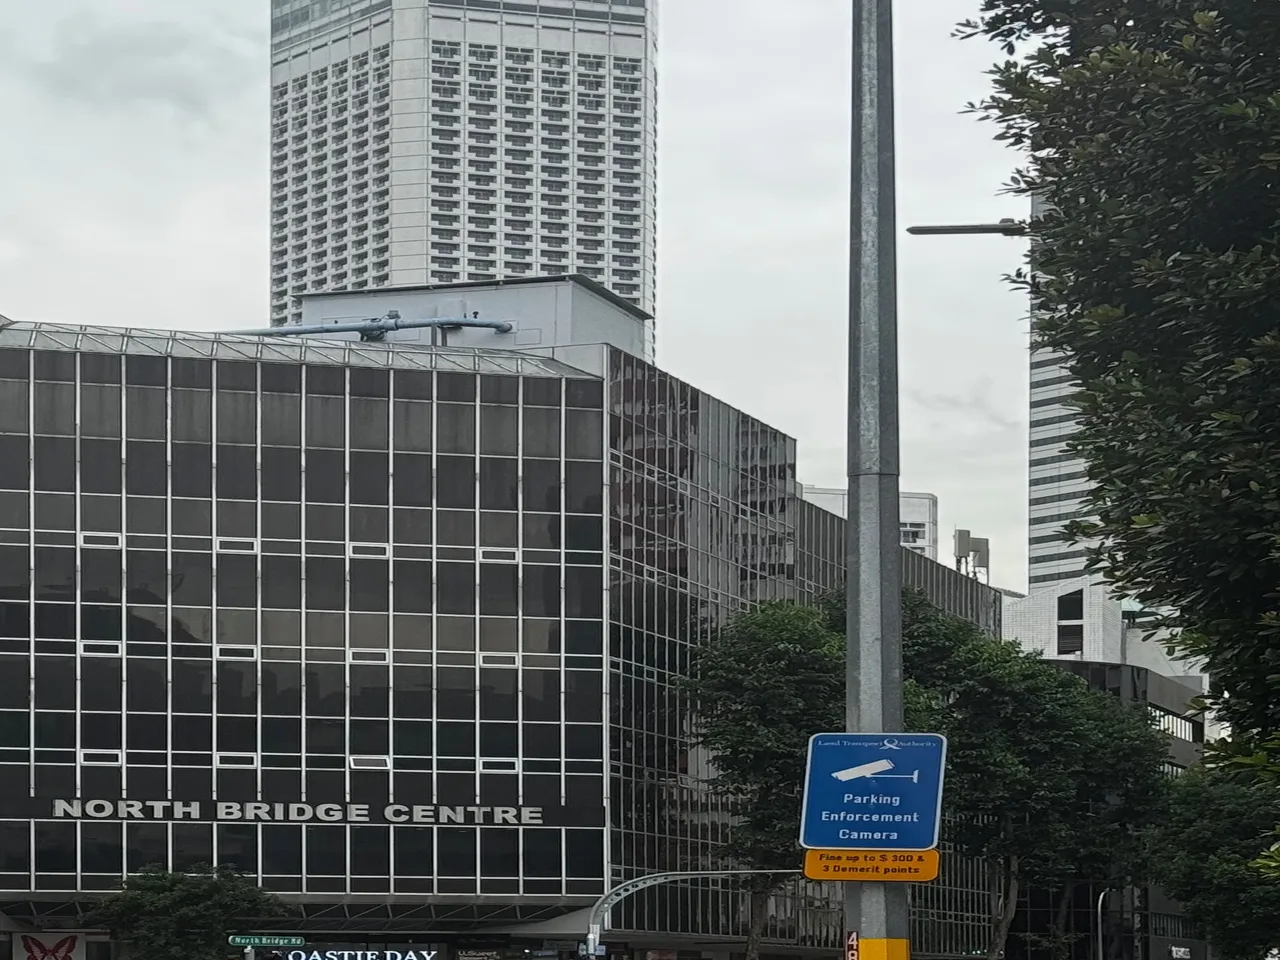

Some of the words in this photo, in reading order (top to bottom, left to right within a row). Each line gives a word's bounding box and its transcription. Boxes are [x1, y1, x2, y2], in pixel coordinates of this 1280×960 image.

[843, 793, 900, 806] Parking
[53, 799, 200, 818] NORTH
[216, 802, 370, 821] BRIDGE
[383, 805, 544, 824] CENTRE
[821, 811, 919, 822] Enforcement
[838, 829, 898, 840] Camera
[819, 853, 842, 861] Fine
[846, 855, 859, 863] up
[864, 854, 876, 862] to
[833, 865, 880, 873] Demerit
[883, 866, 920, 874] points
[261, 937, 289, 945] Bridge
